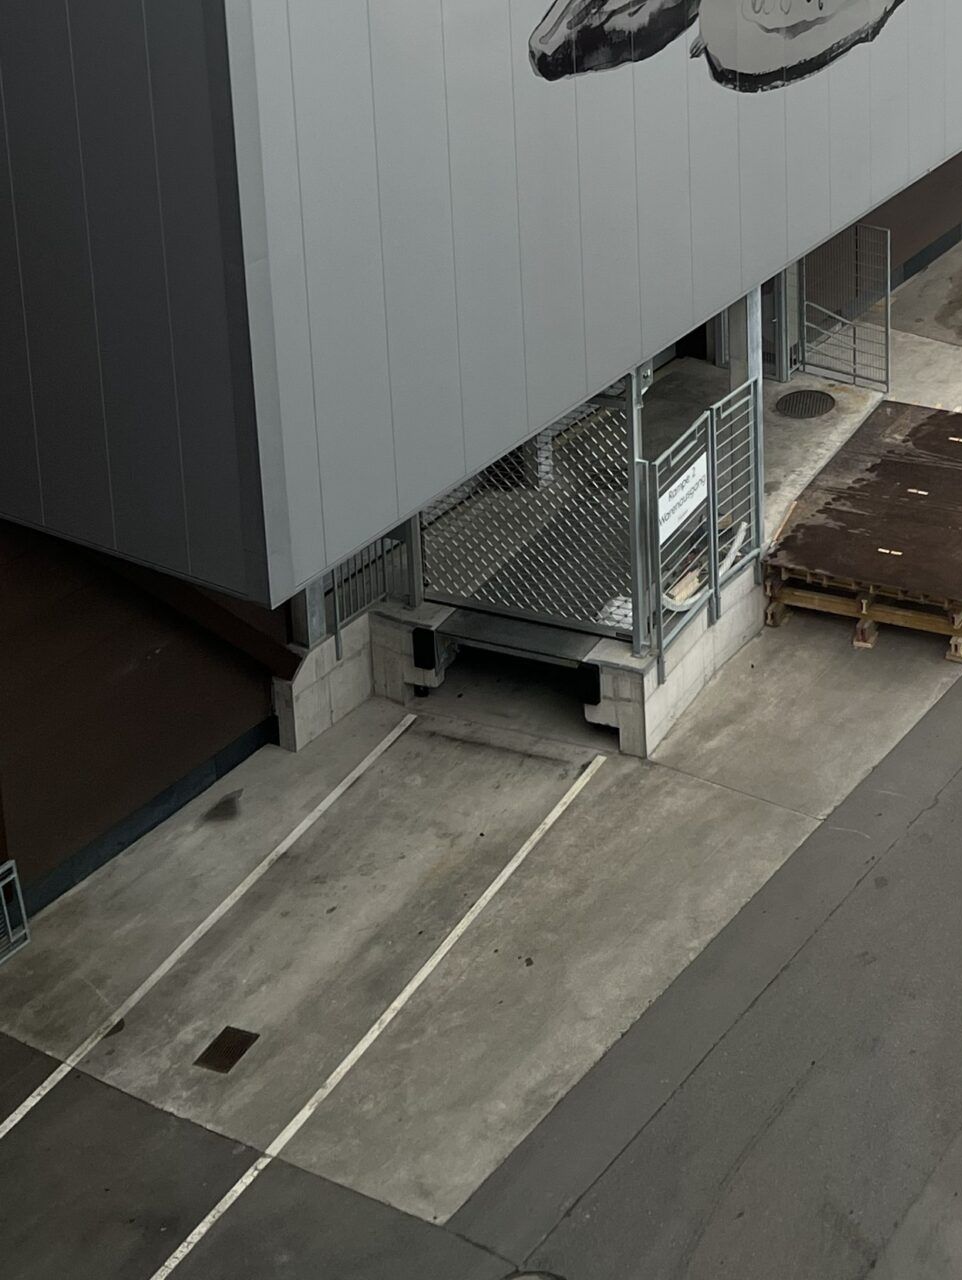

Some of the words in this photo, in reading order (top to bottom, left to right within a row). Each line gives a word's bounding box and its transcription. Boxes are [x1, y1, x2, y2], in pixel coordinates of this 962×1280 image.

[658, 475, 706, 526] Warenausgang
[668, 475, 690, 501] Rampe
[691, 467, 697, 478] 2
